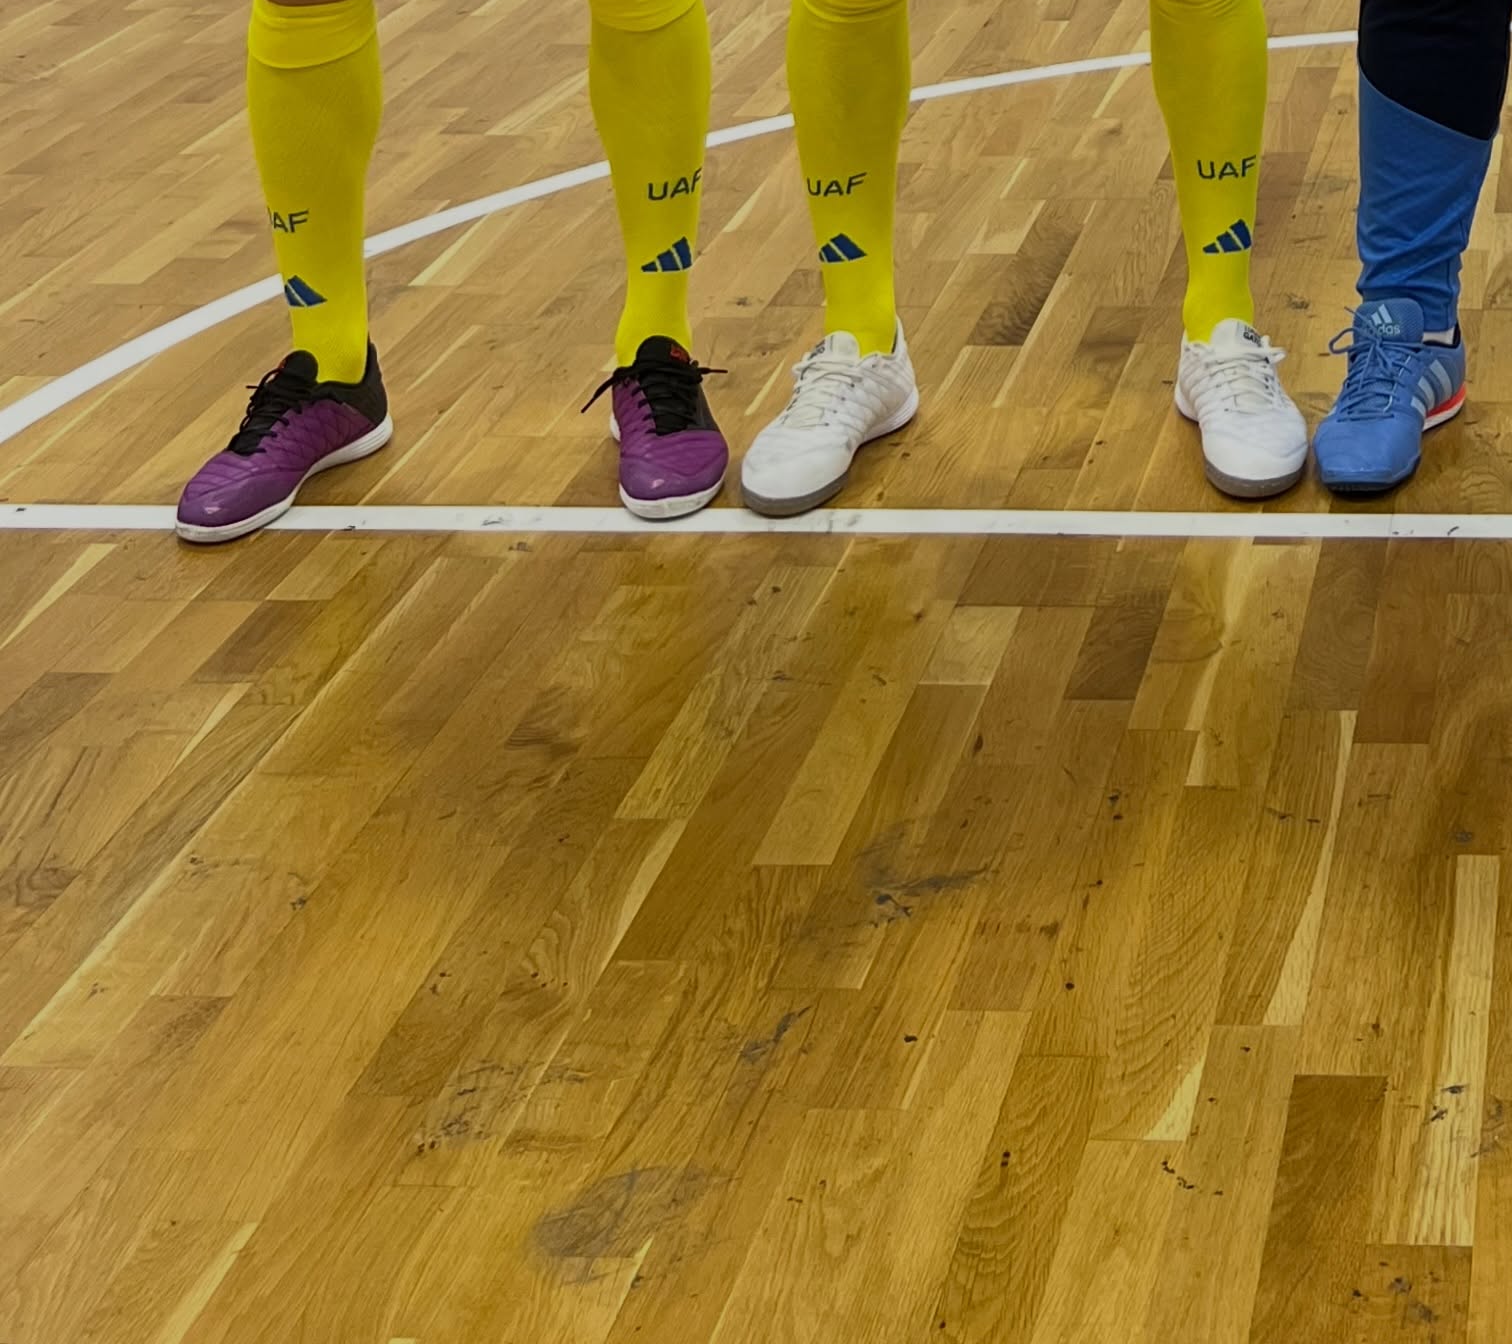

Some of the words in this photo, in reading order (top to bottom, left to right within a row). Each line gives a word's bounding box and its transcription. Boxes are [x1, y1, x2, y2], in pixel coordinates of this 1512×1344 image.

[1197, 154, 1257, 181] UAF
[648, 167, 703, 201] UAF
[806, 172, 868, 197] UAF
